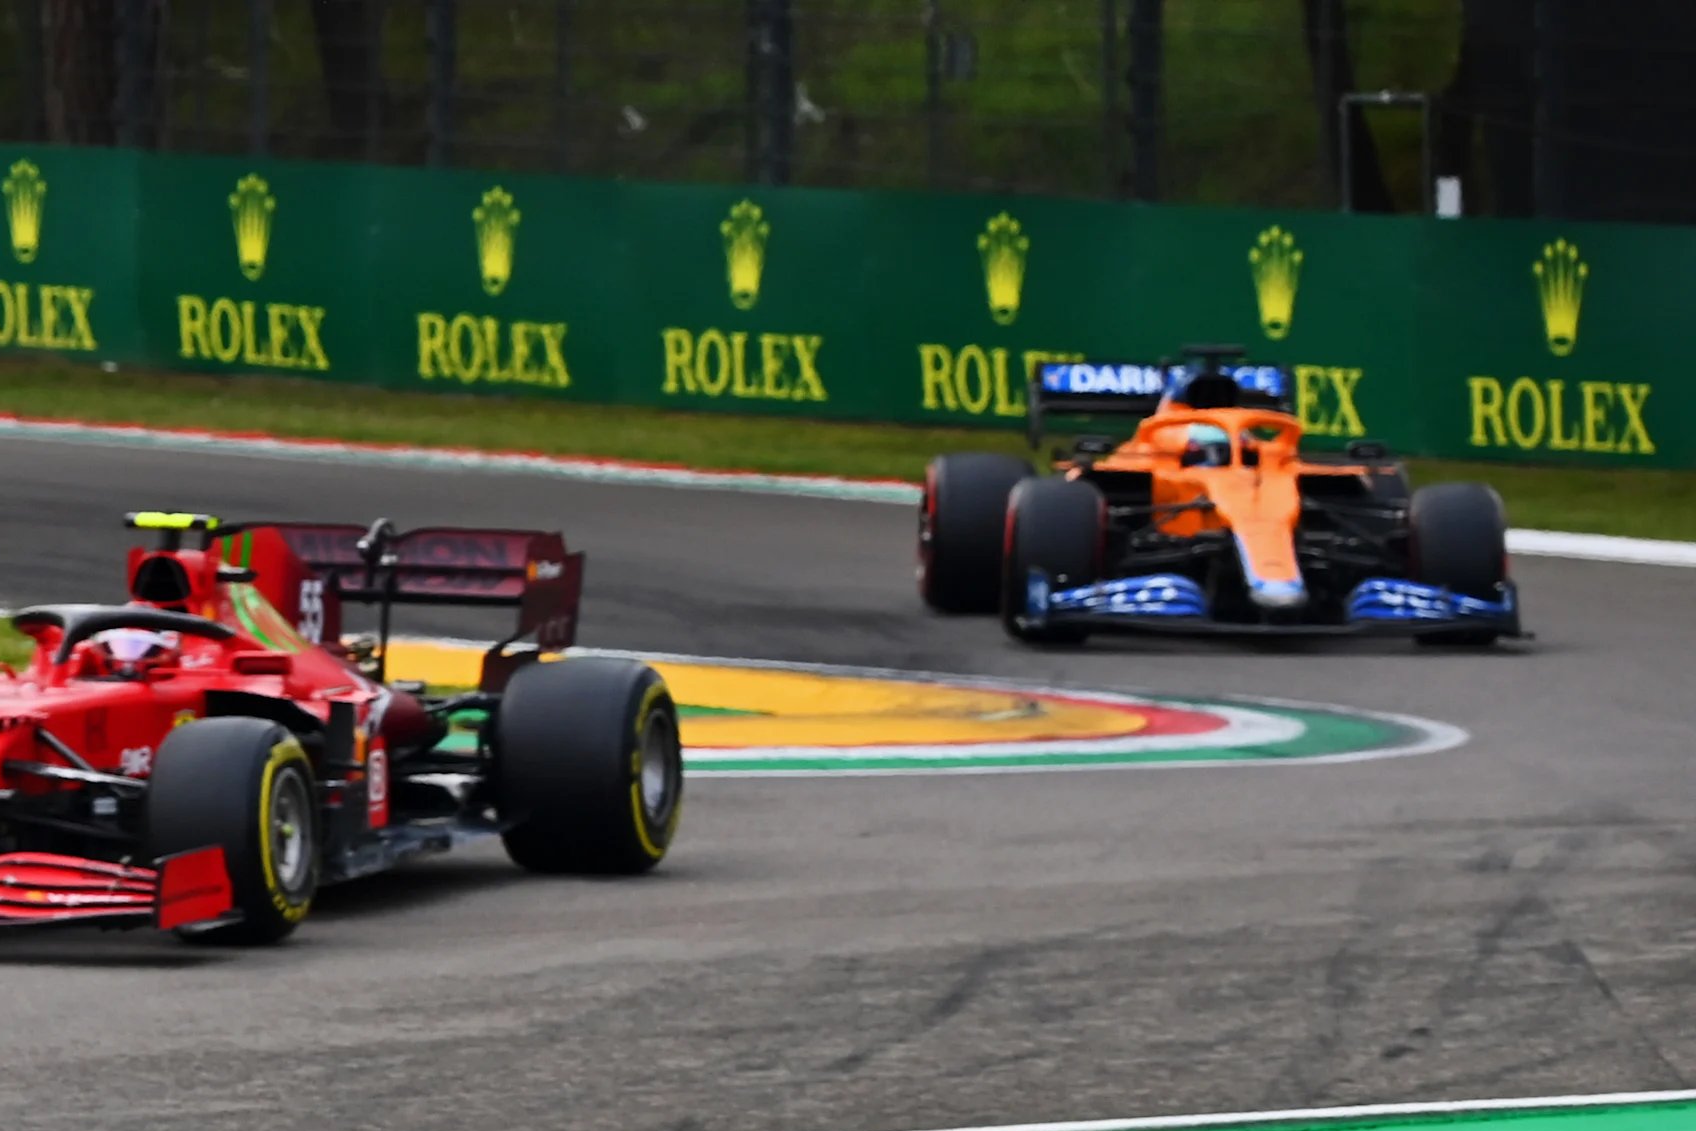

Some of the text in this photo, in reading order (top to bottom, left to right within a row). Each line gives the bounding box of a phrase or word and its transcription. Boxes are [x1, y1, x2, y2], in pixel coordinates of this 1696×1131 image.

[179, 296, 327, 369] ROLEX
[418, 313, 569, 385] ROLEX
[664, 329, 824, 401] ROLEX
[919, 343, 1087, 418] ROL
[1469, 377, 1655, 454] ROLEX
